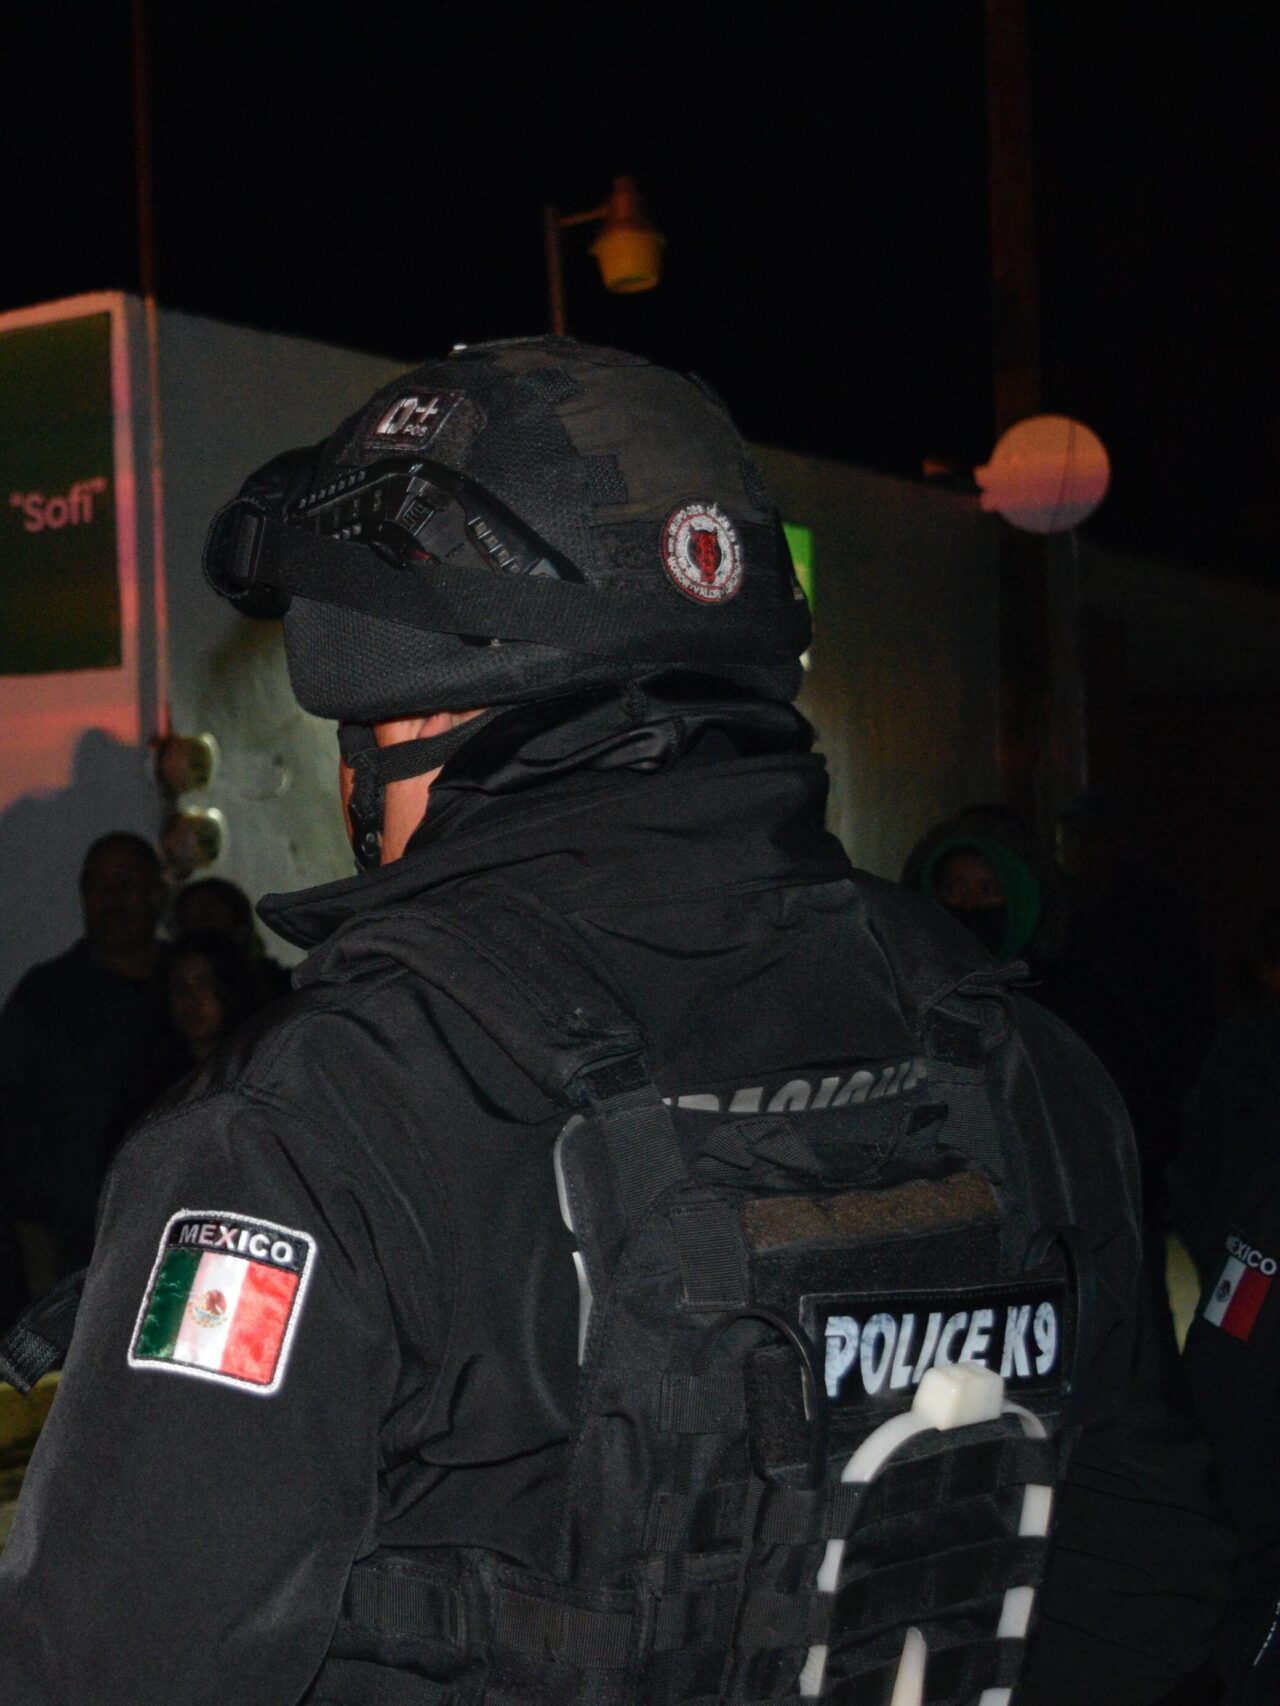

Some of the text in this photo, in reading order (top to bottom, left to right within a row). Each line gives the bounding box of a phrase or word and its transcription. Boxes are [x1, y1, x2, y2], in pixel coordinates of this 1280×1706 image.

[178, 1223, 294, 1263] MEXICO
[824, 1301, 1057, 1397] POLICE K9
